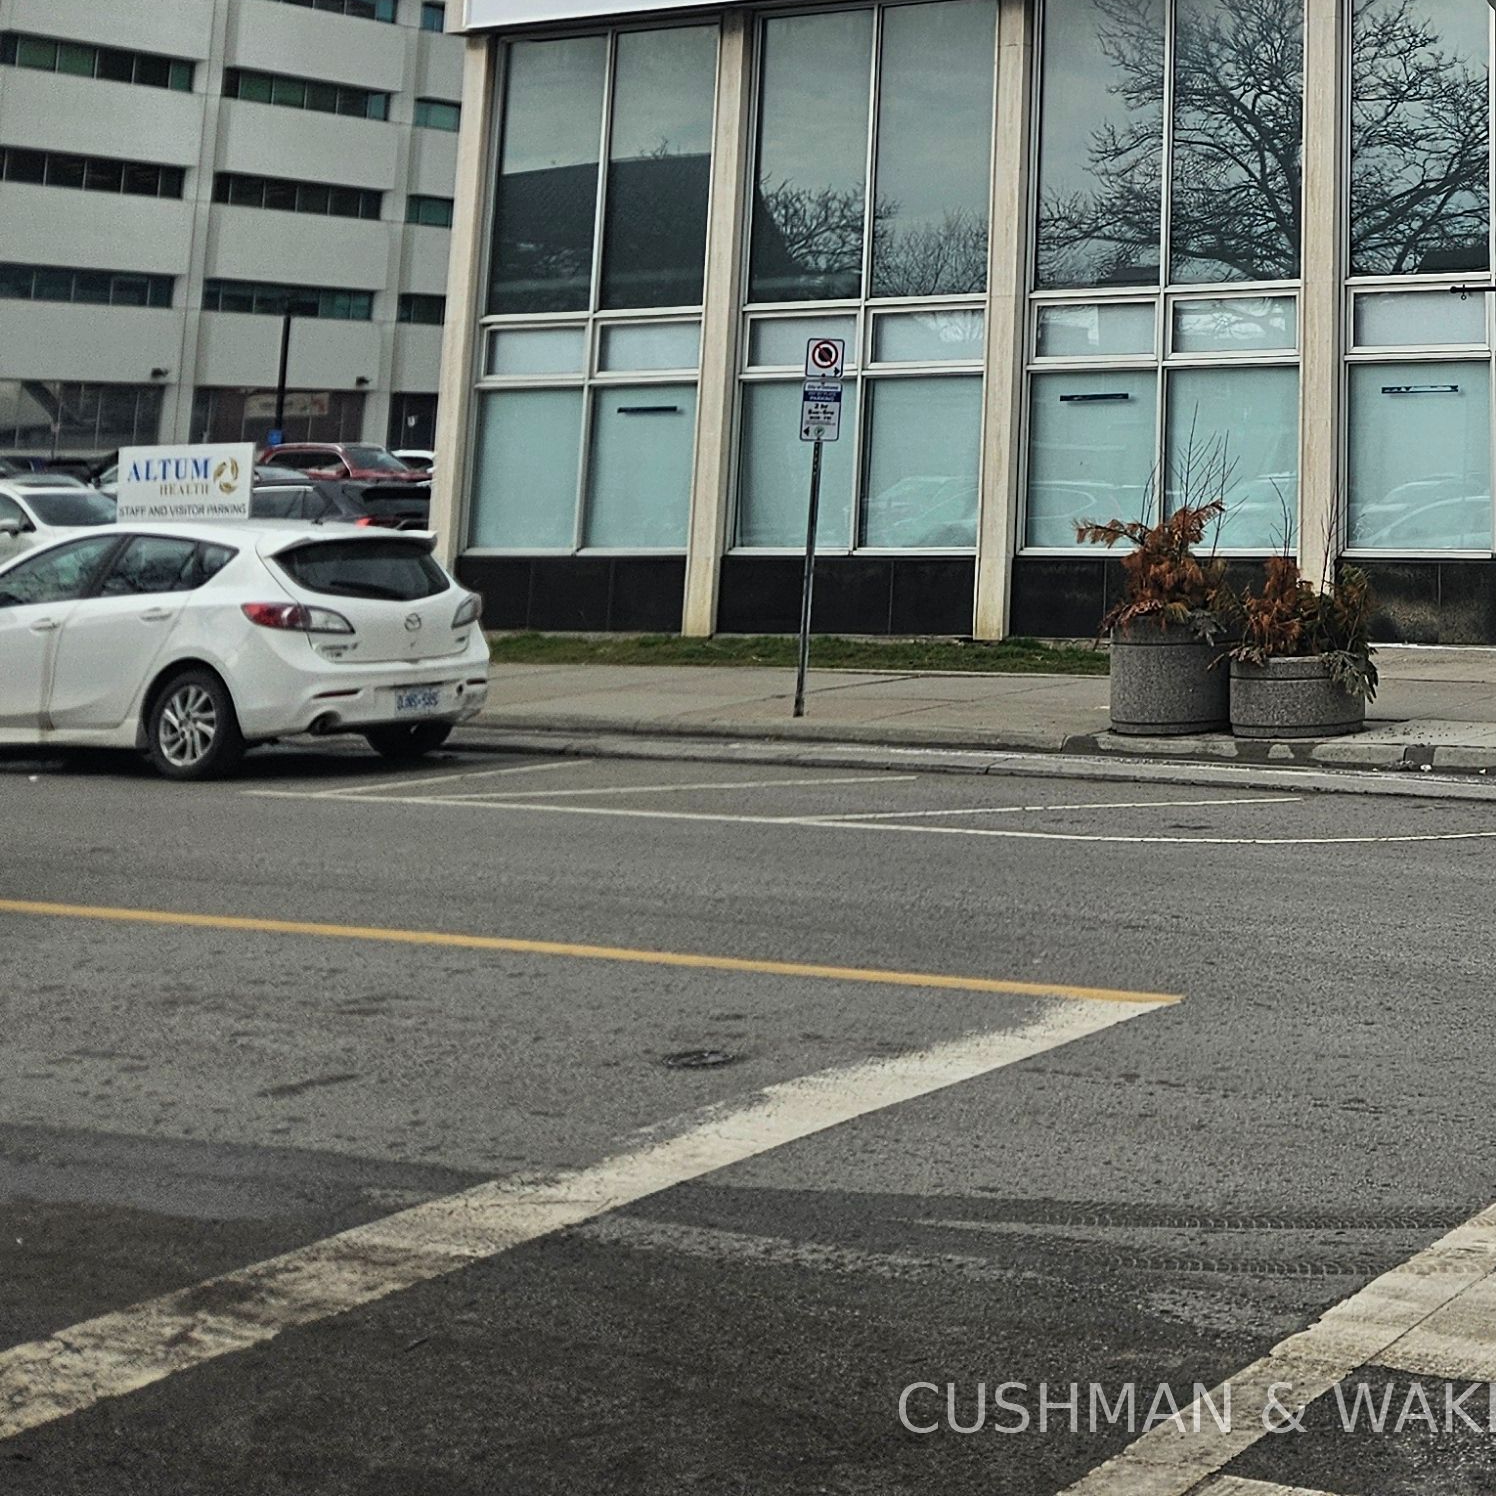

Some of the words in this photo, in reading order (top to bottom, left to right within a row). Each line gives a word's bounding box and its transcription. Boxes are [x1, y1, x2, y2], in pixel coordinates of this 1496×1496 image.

[128, 457, 212, 482] ALTUM
[160, 483, 209, 497] HEALTH
[119, 505, 145, 517] STAFF
[149, 505, 168, 516] AND
[169, 504, 206, 516] VISITOR
[207, 503, 247, 514] PARKING
